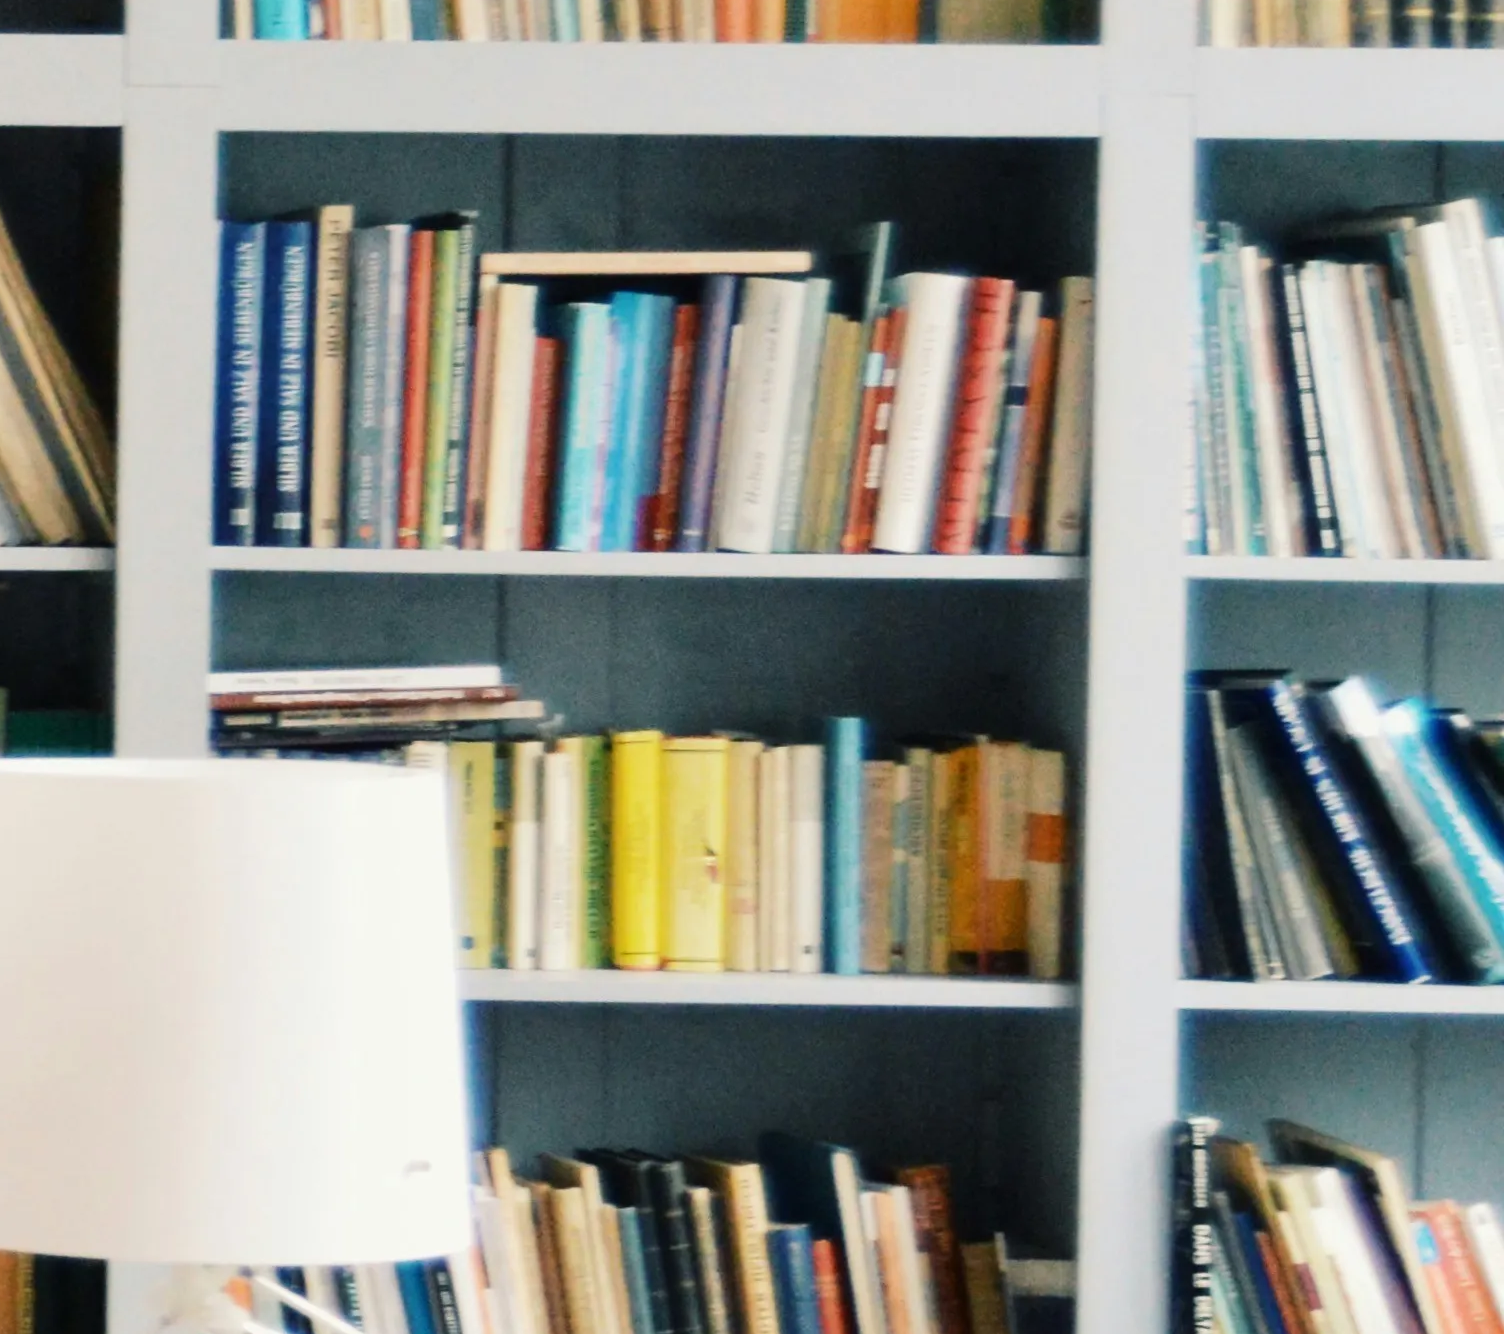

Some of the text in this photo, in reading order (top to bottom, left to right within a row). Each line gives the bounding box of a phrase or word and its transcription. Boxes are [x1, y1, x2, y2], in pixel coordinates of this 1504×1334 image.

[232, 349, 253, 366] IN
[281, 353, 301, 370] IN
[231, 406, 253, 437] UND
[278, 409, 301, 441] UND
[1192, 1223, 1212, 1264] DANS
[1193, 1271, 1211, 1287] LE
